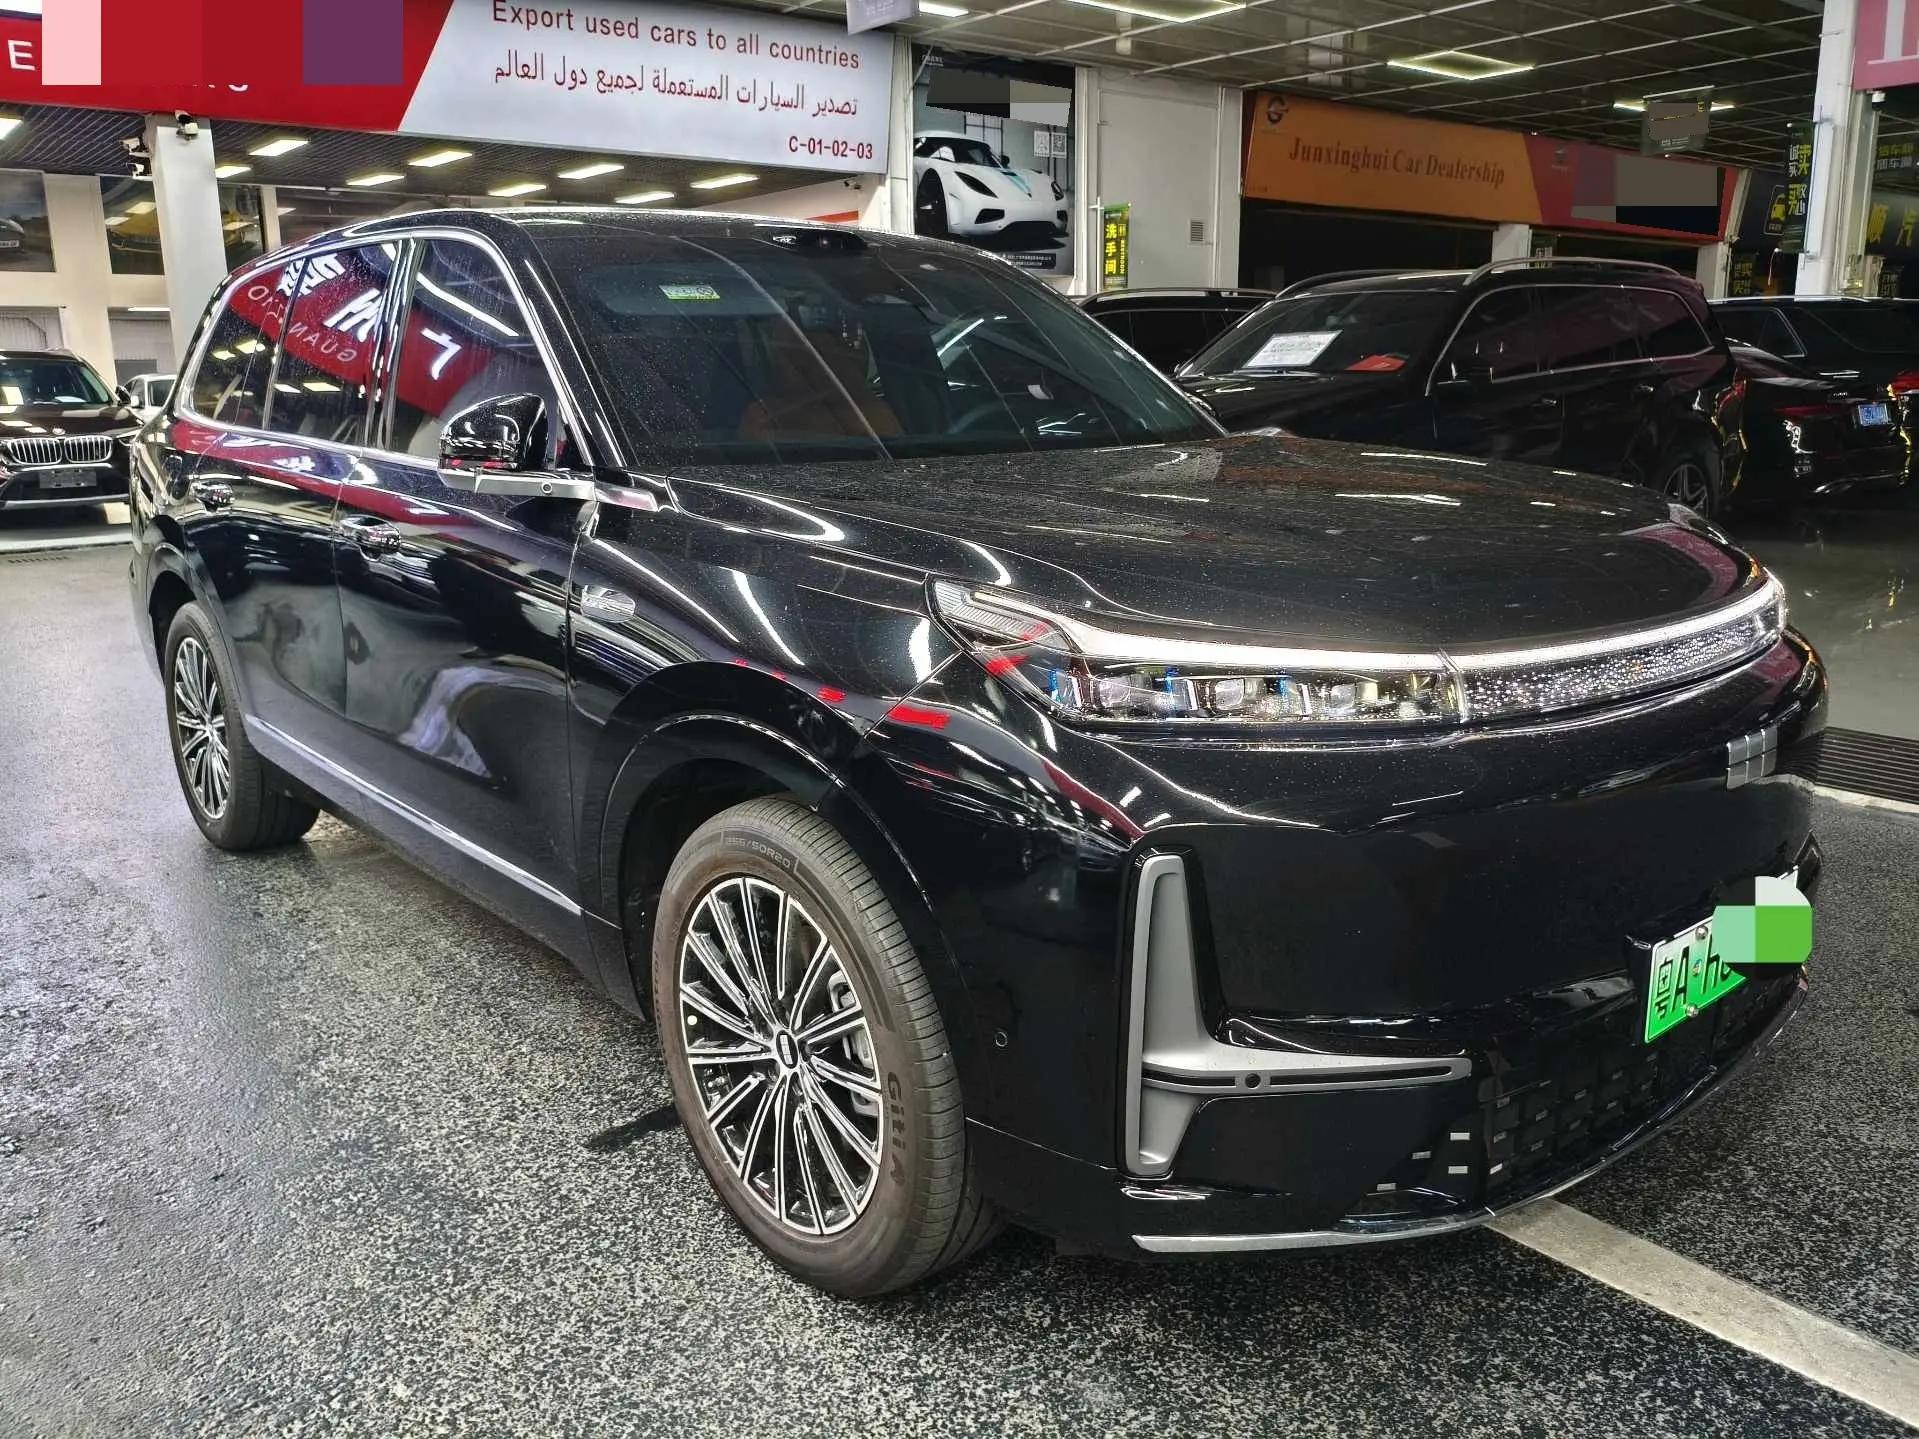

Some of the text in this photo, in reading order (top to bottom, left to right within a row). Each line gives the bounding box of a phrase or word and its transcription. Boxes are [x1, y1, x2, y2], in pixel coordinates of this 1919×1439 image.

[493, 0, 859, 69] Export used cars to all countries
[495, 49, 858, 117] تصدير السيارات المستعملة لجميع دول العالم
[789, 135, 873, 160] C-01-02-03
[1289, 137, 1505, 190] Junxinghui Car Dealership
[1105, 223, 1118, 275] 洗手间
